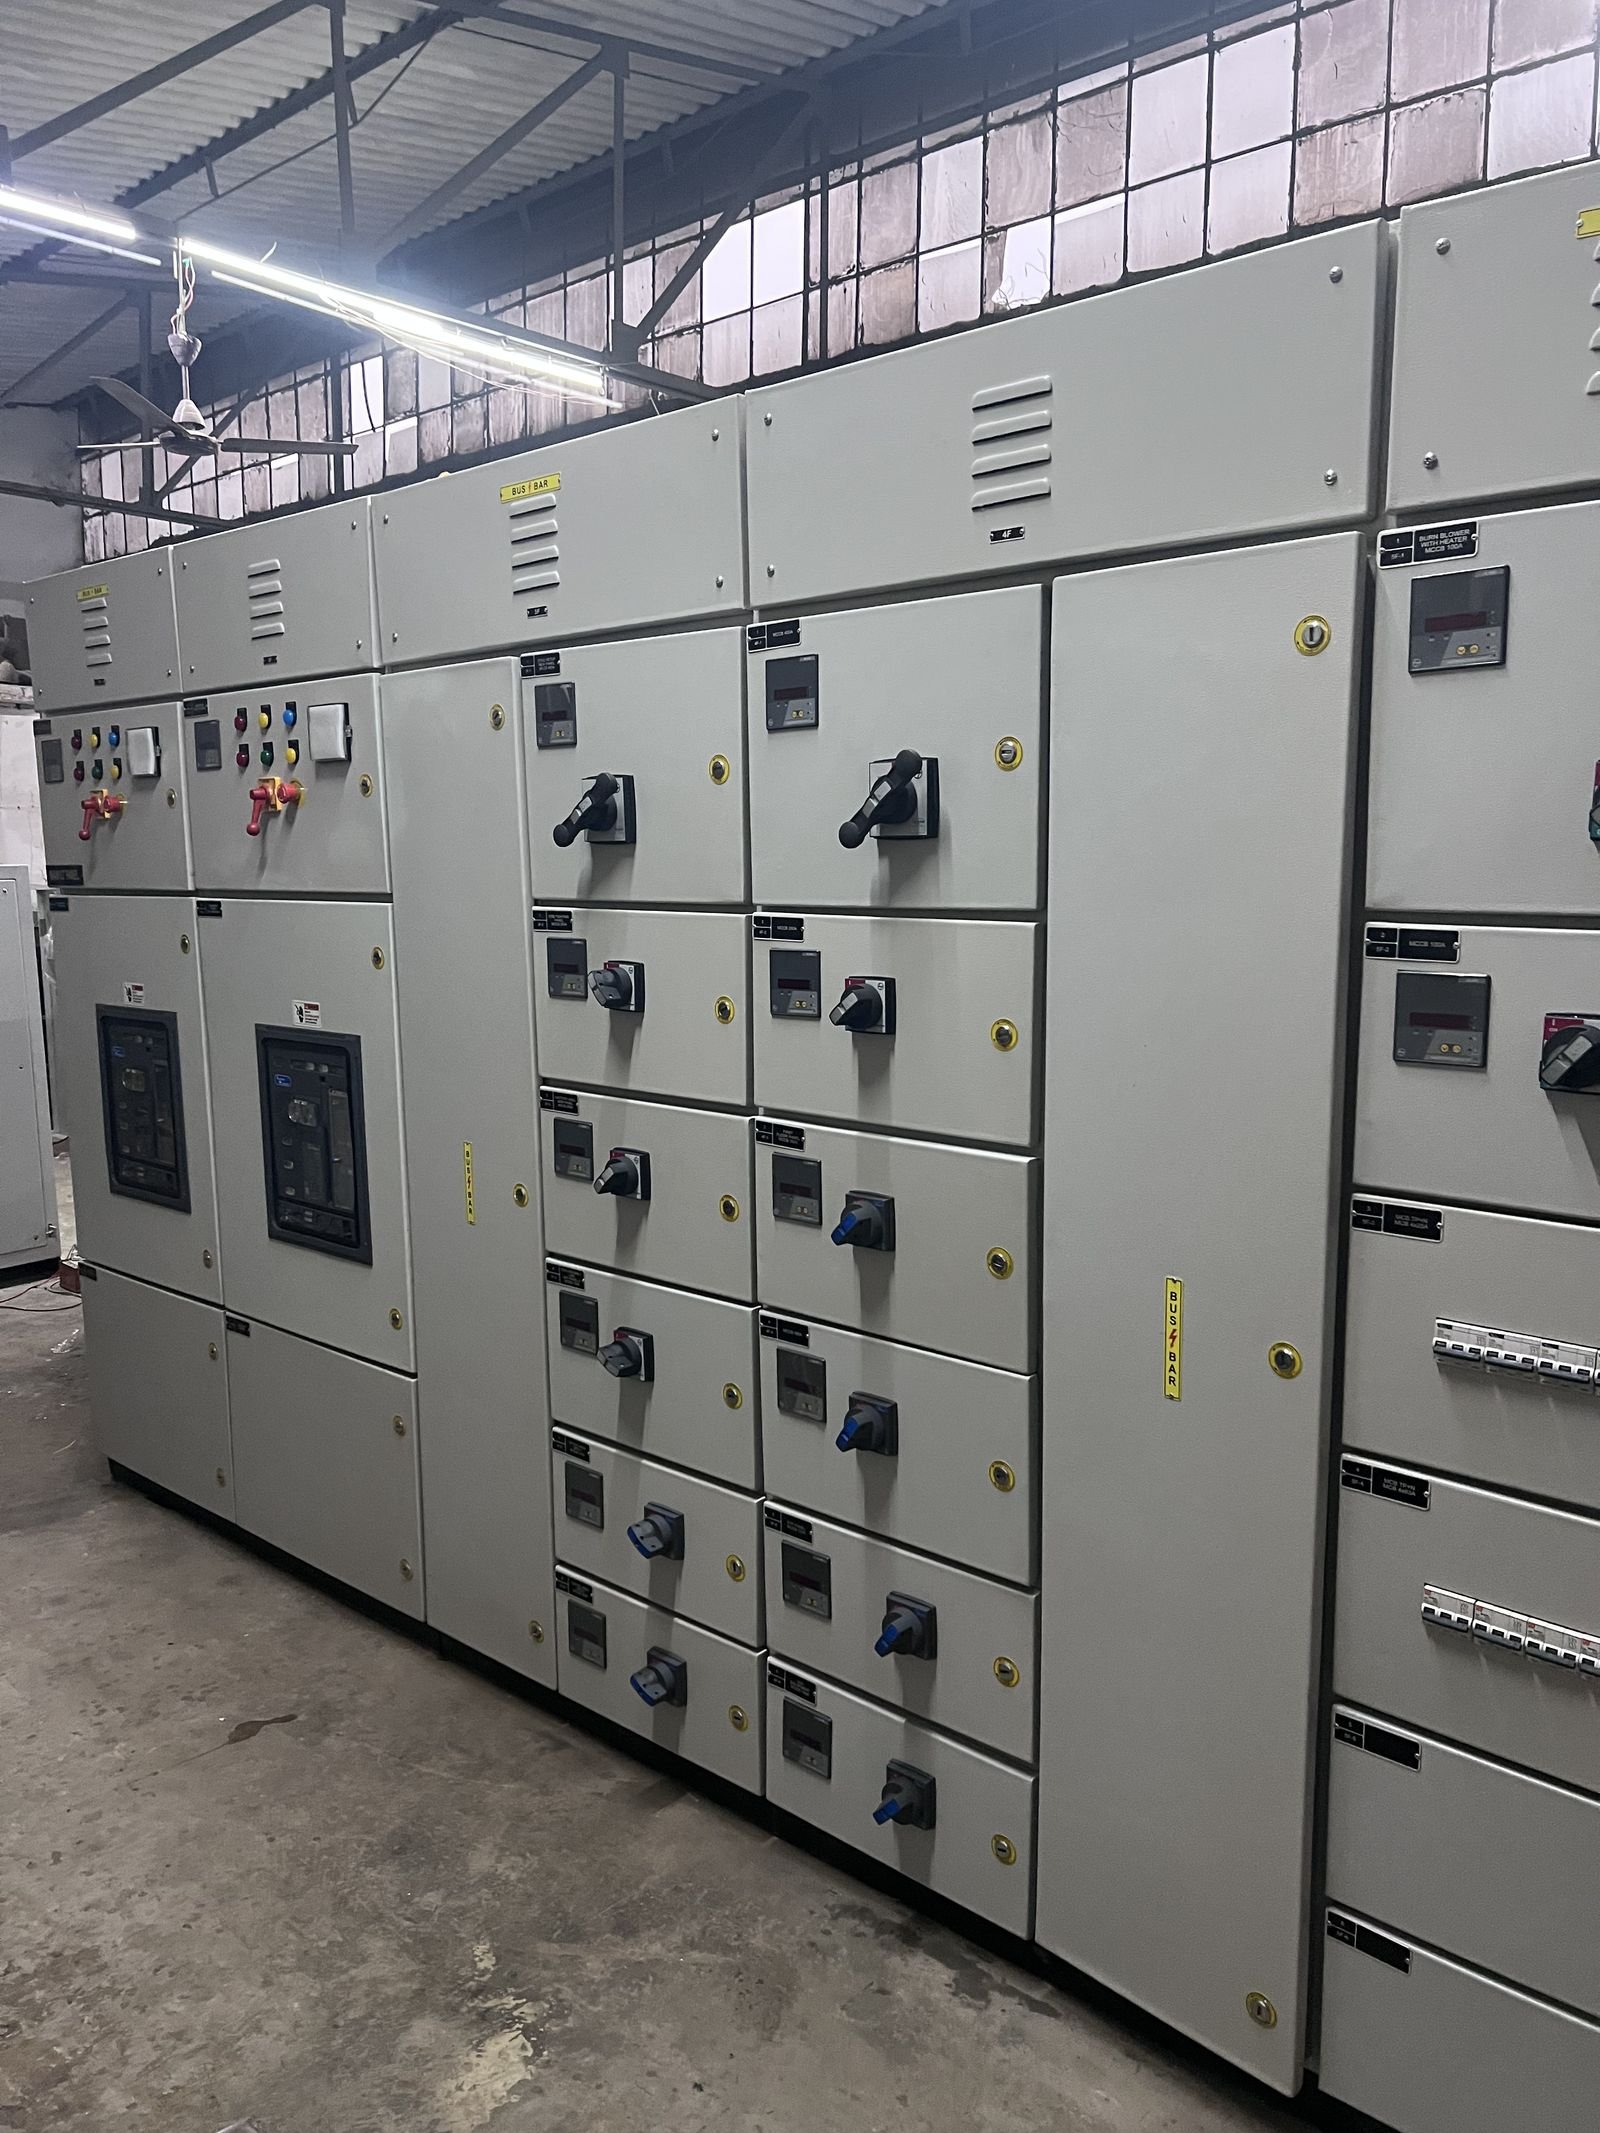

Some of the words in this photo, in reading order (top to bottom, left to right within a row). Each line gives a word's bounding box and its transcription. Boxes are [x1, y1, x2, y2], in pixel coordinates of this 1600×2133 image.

[511, 485, 526, 496] BUS
[533, 479, 549, 490] BAR
[1001, 529, 1012, 538] 4F
[1418, 533, 1439, 542] BURN
[1439, 528, 1471, 539] BLOWER
[1420, 540, 1439, 548] WITH
[1439, 535, 1468, 545] HEATER
[1424, 545, 1445, 553] MCCB
[1169, 1291, 1178, 1325] BUS
[1168, 1352, 1177, 1386] BAR
